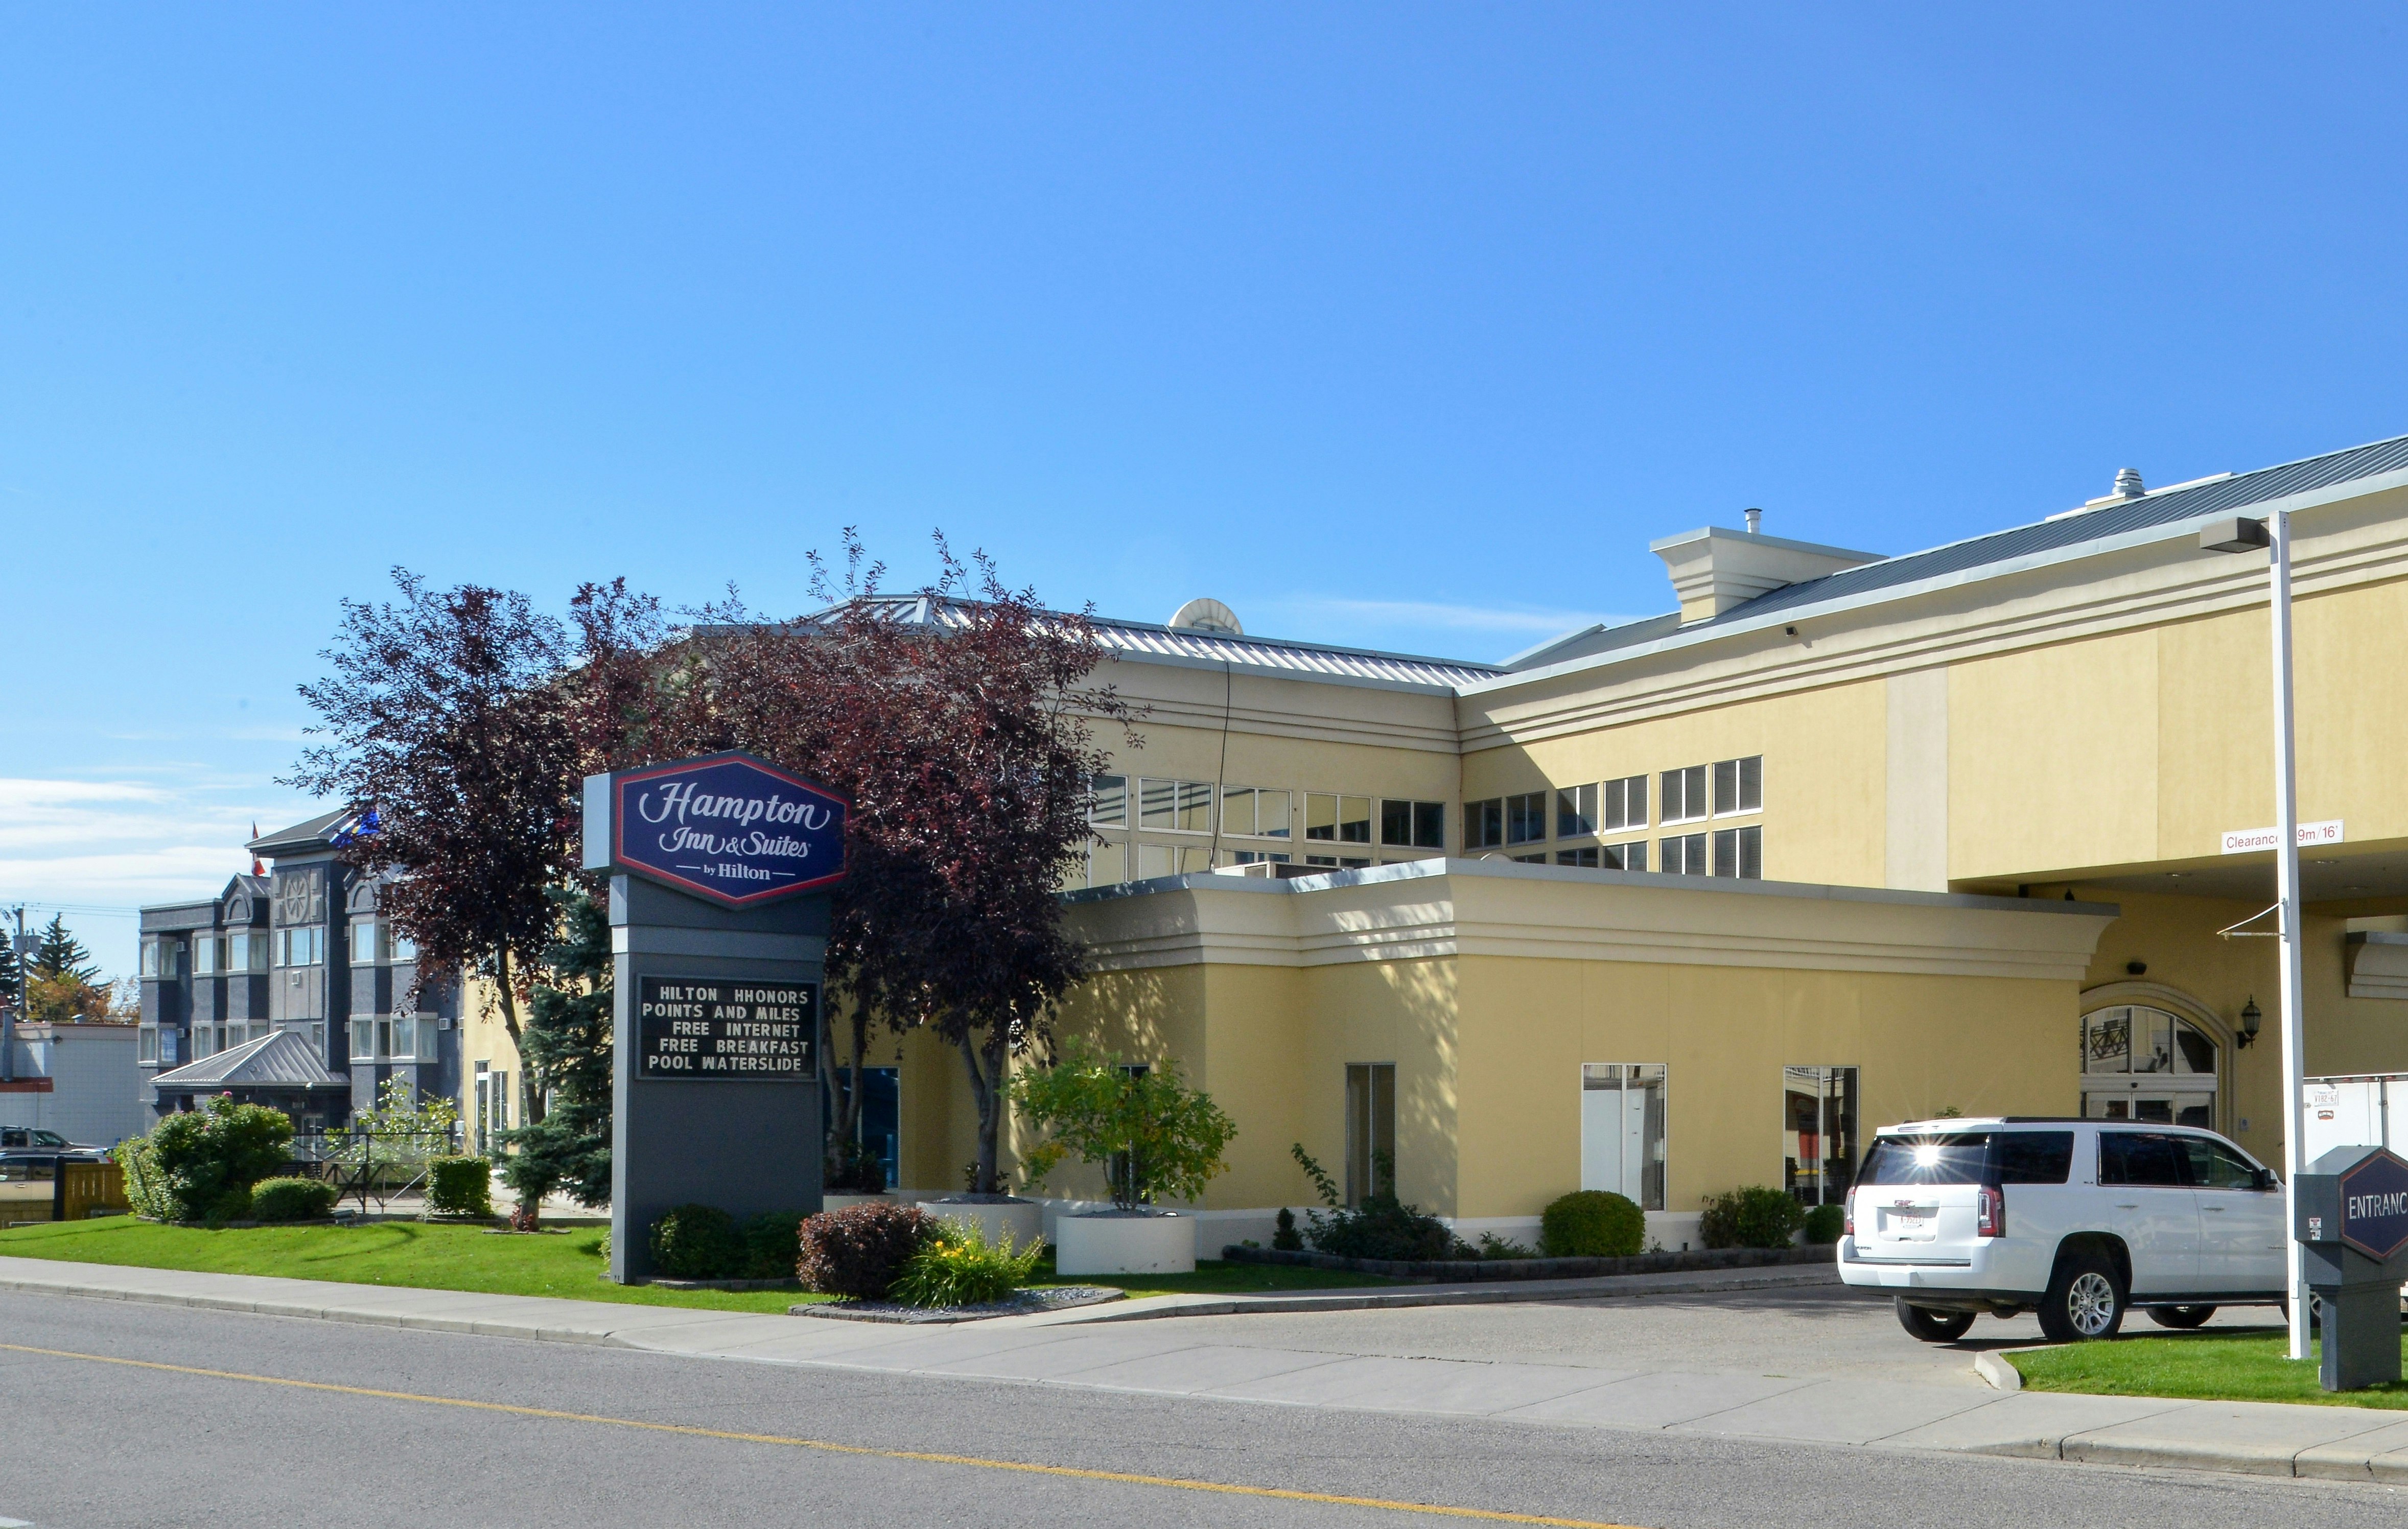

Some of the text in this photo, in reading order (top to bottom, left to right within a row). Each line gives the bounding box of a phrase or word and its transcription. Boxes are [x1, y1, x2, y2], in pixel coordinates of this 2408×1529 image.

[639, 782, 830, 830] Hampton
[659, 827, 809, 858] Inn & Suites
[2227, 835, 2278, 848] Clearanc
[704, 863, 770, 880] by Hilton
[660, 986, 808, 1004] HILTON HHONORS
[642, 1003, 800, 1021] POINTS AND MILES
[673, 1021, 800, 1038] FREE INTERNET
[660, 1039, 808, 1054] FREE BREAKFAST
[649, 1055, 801, 1071] POOL WATERSLIDE
